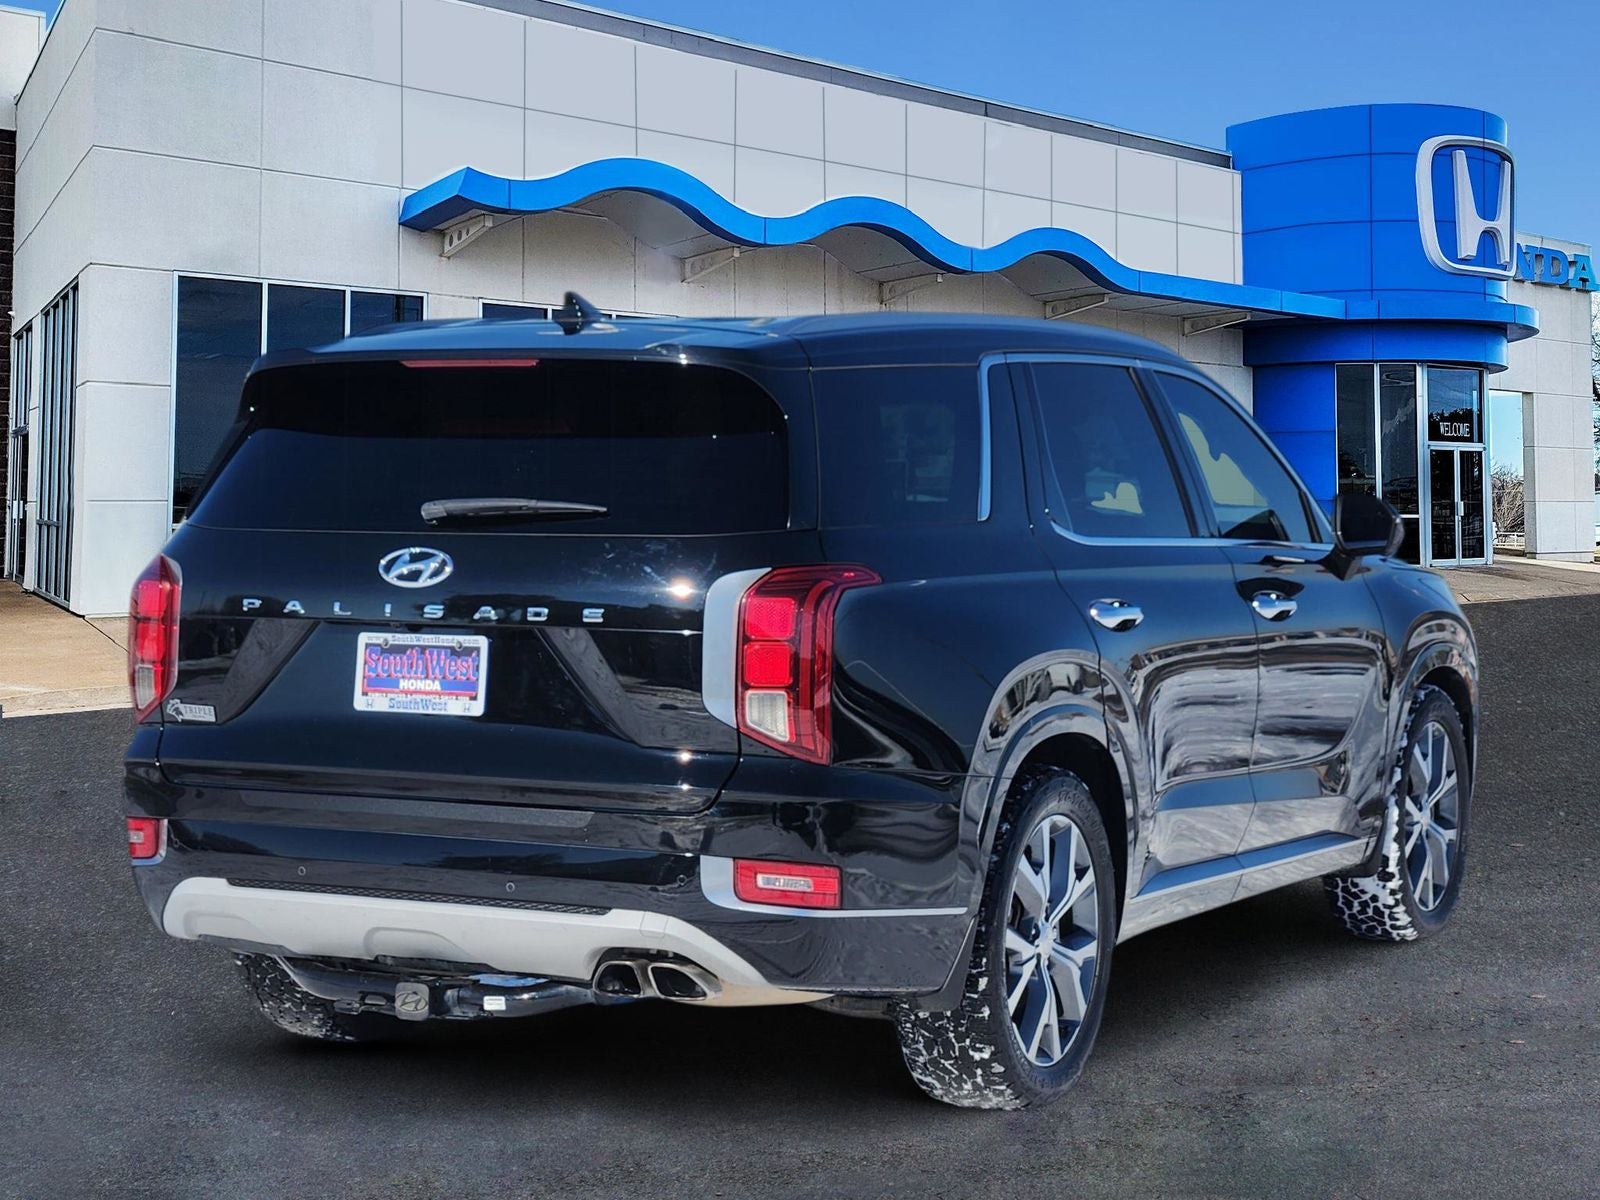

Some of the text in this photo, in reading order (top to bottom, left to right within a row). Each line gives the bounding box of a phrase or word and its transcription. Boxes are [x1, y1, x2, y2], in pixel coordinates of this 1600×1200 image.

[1513, 242, 1600, 291] NDA
[1439, 422, 1471, 437] WELCOME
[241, 598, 605, 624] PALISADE
[399, 678, 442, 691] HONDA
